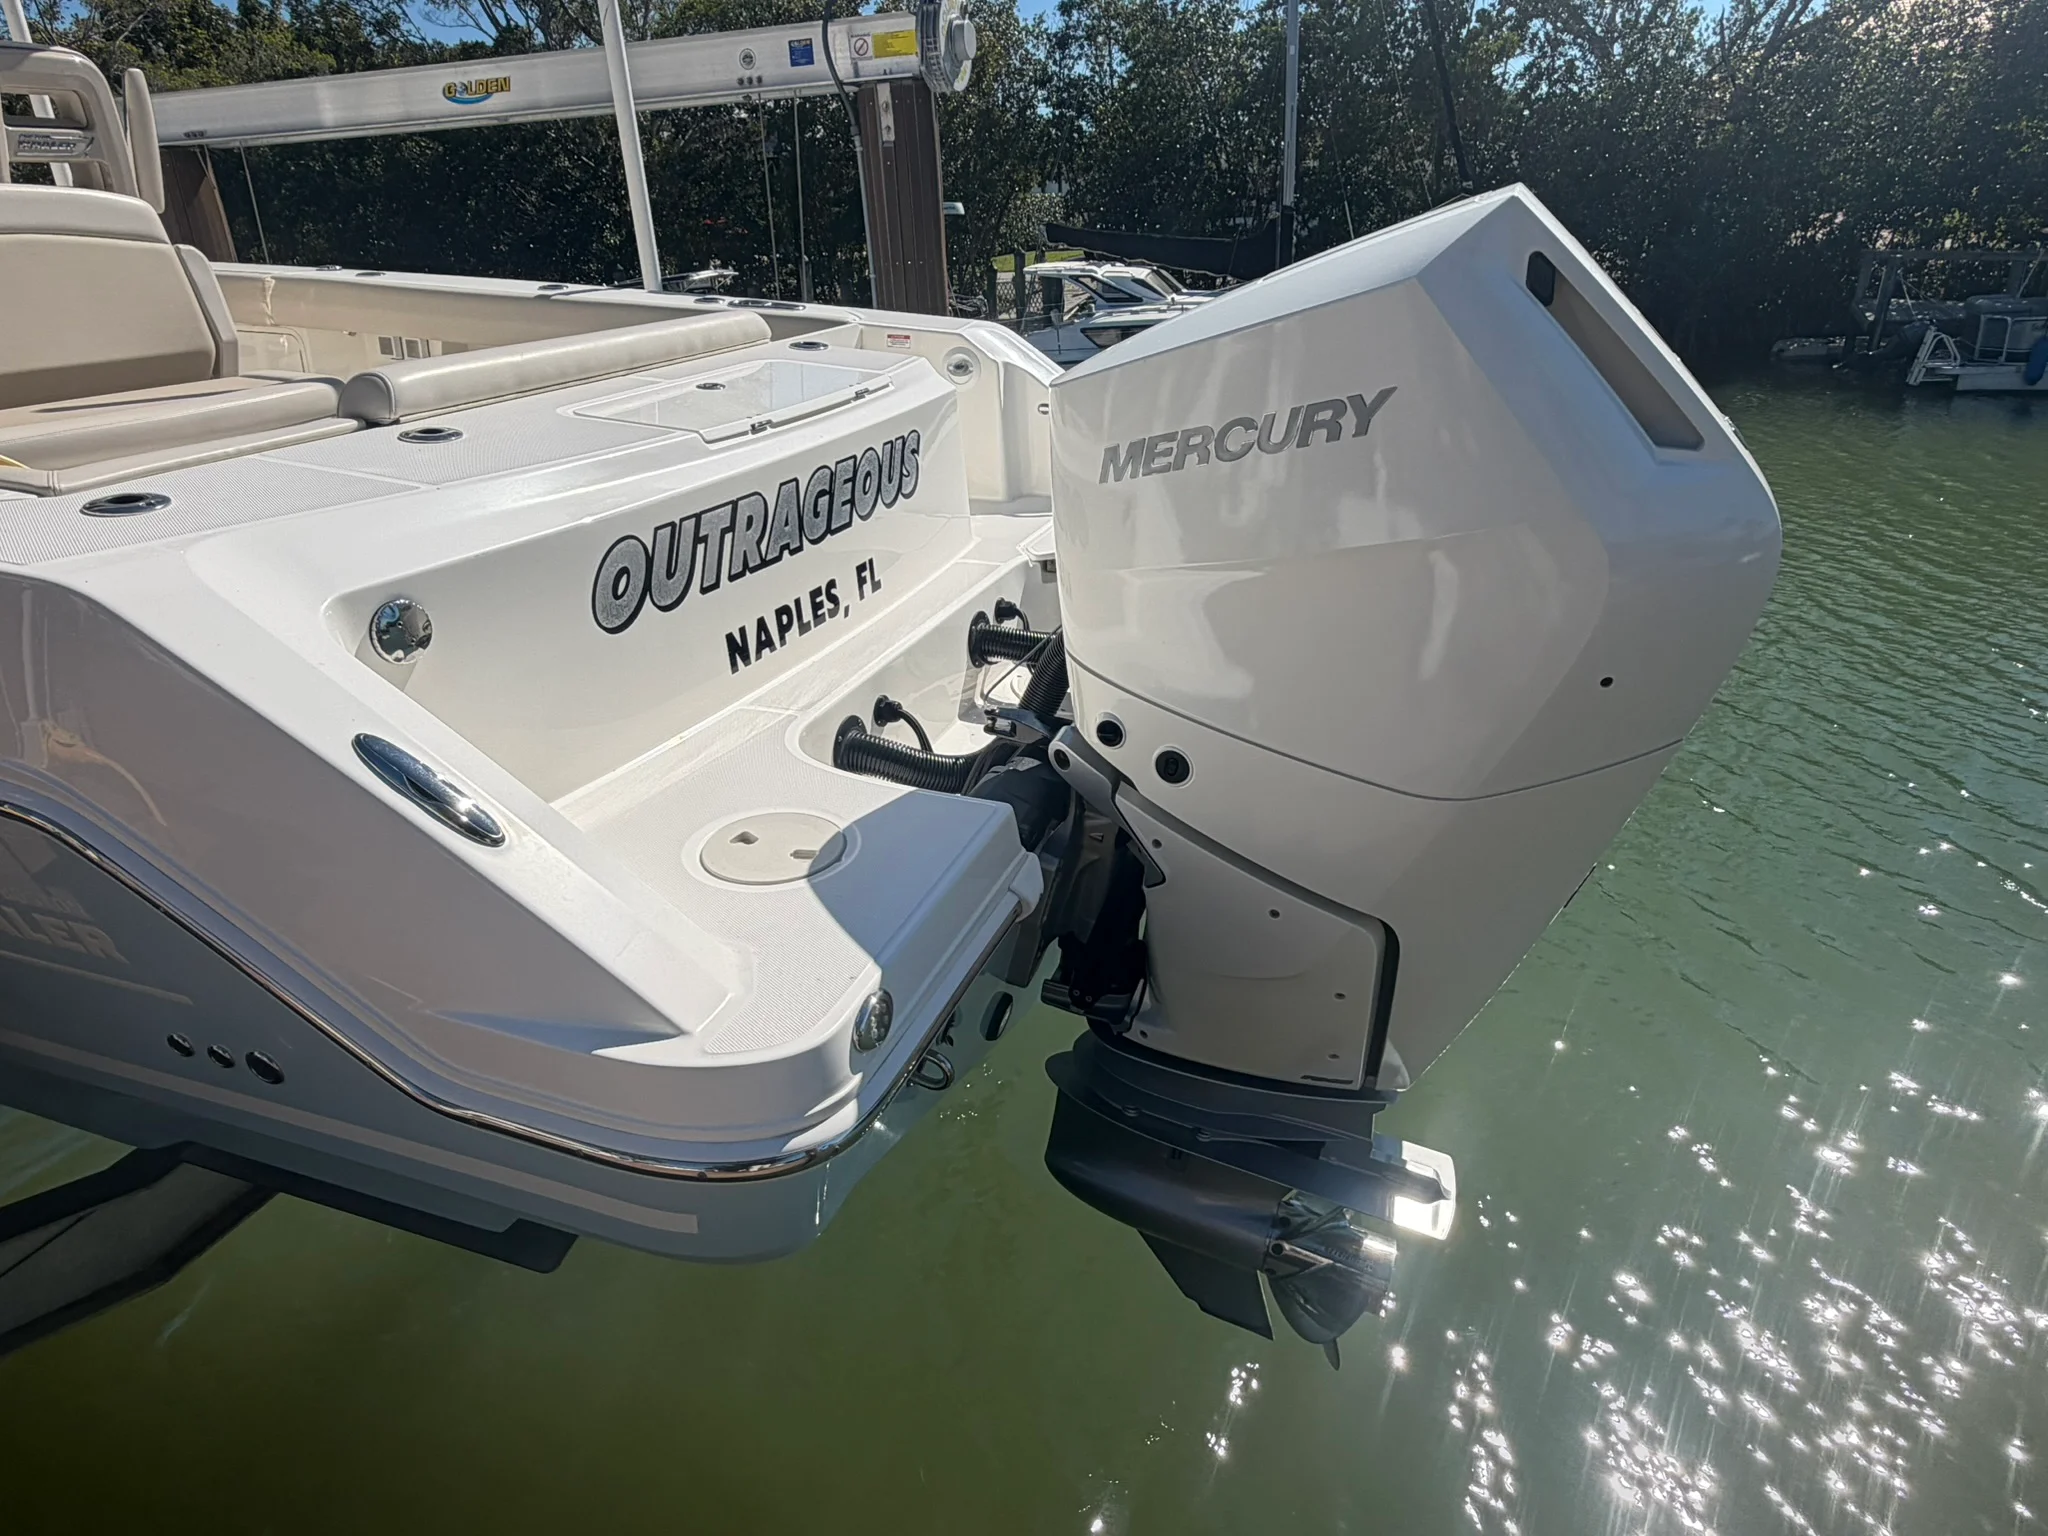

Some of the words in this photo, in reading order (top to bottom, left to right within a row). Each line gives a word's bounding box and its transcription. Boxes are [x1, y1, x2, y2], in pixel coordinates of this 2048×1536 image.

[1098, 385, 1398, 485] MERCURY
[591, 429, 921, 635] OUTRAGEOUS
[725, 578, 850, 675] NAPLES,
[855, 557, 882, 601] FL
